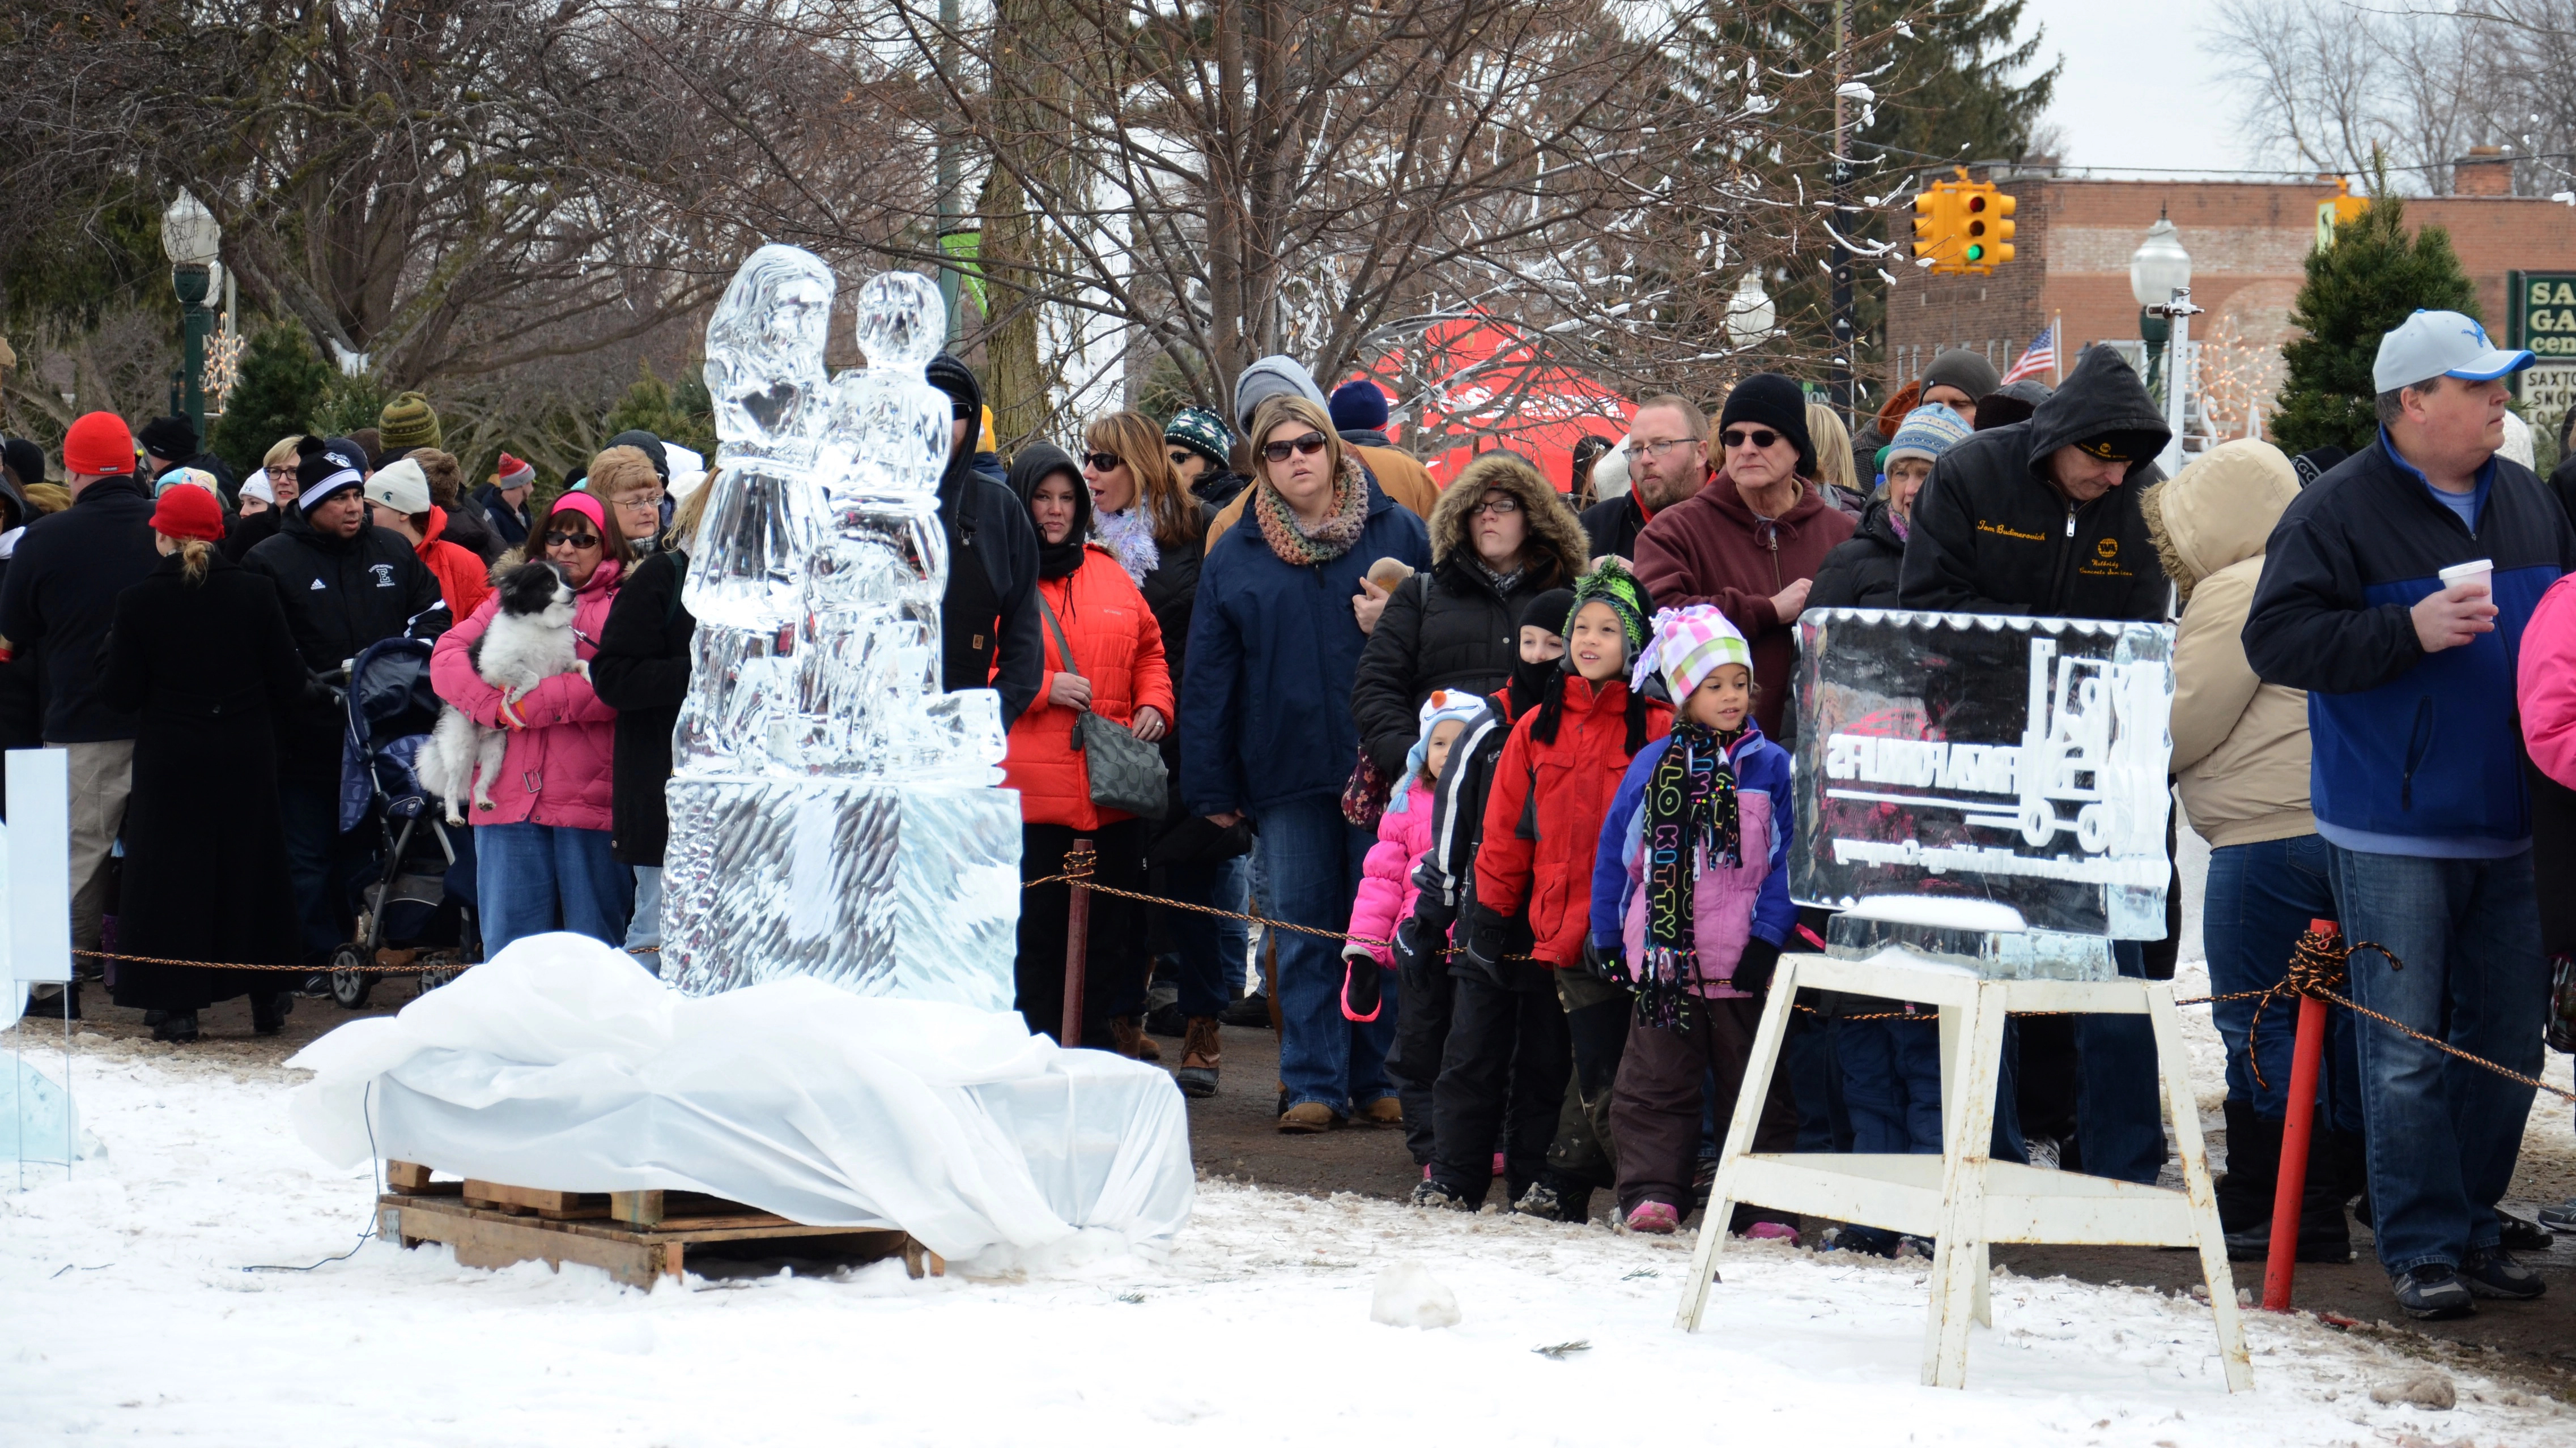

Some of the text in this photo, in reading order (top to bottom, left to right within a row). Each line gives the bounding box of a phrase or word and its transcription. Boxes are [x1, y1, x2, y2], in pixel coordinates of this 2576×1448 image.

[2530, 282, 2576, 305] SA
[2530, 309, 2576, 331] GA
[2530, 337, 2576, 354] cen
[1804, 391, 1831, 404] ION
[1977, 519, 1995, 532] Tom
[2092, 559, 2122, 569] Walbridg
[1653, 824, 1679, 939] KITTY
